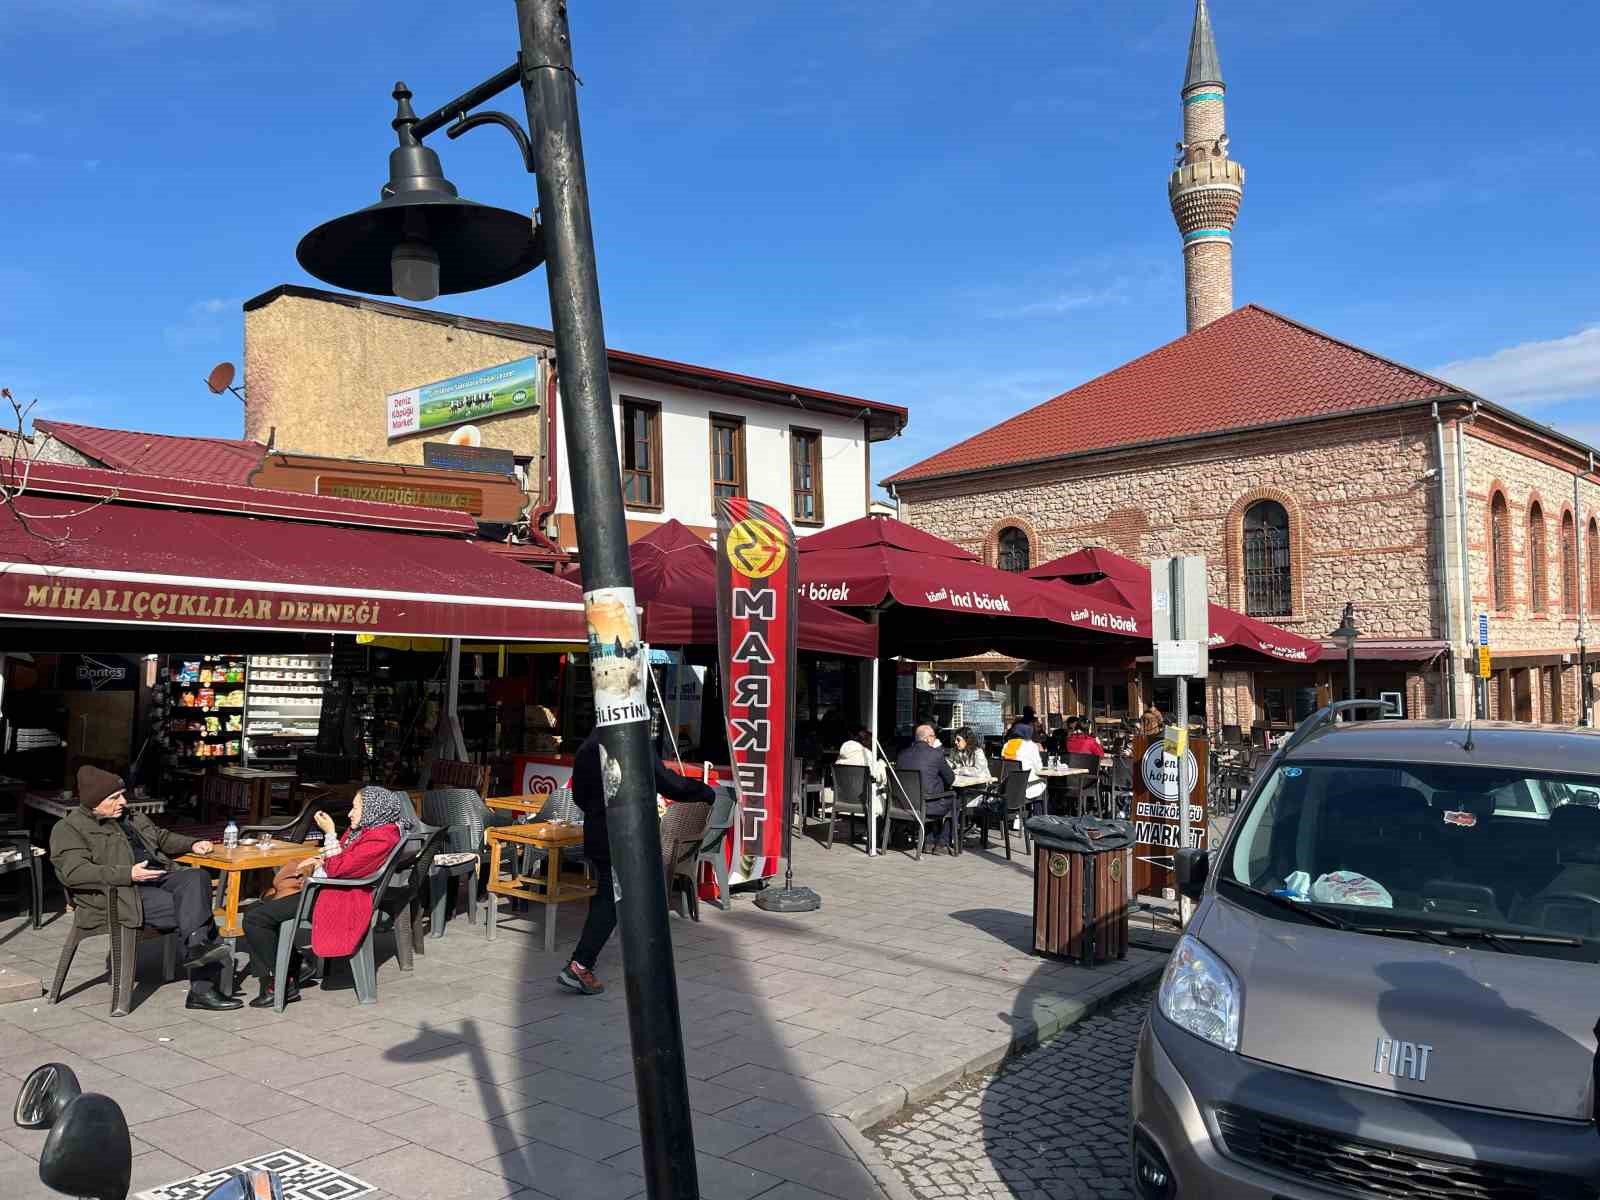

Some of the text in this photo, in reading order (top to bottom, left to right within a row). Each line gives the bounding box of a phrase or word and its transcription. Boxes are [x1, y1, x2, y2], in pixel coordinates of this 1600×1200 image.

[809, 582, 850, 601] börek
[949, 589, 972, 608] inci
[973, 591, 1010, 612] börek
[24, 582, 381, 625] MİHALIÇÇIKLILAR DERNEĞİ
[1091, 610, 1108, 628] inci
[1108, 612, 1138, 633] börek
[1374, 1038, 1433, 1081] FIAT
